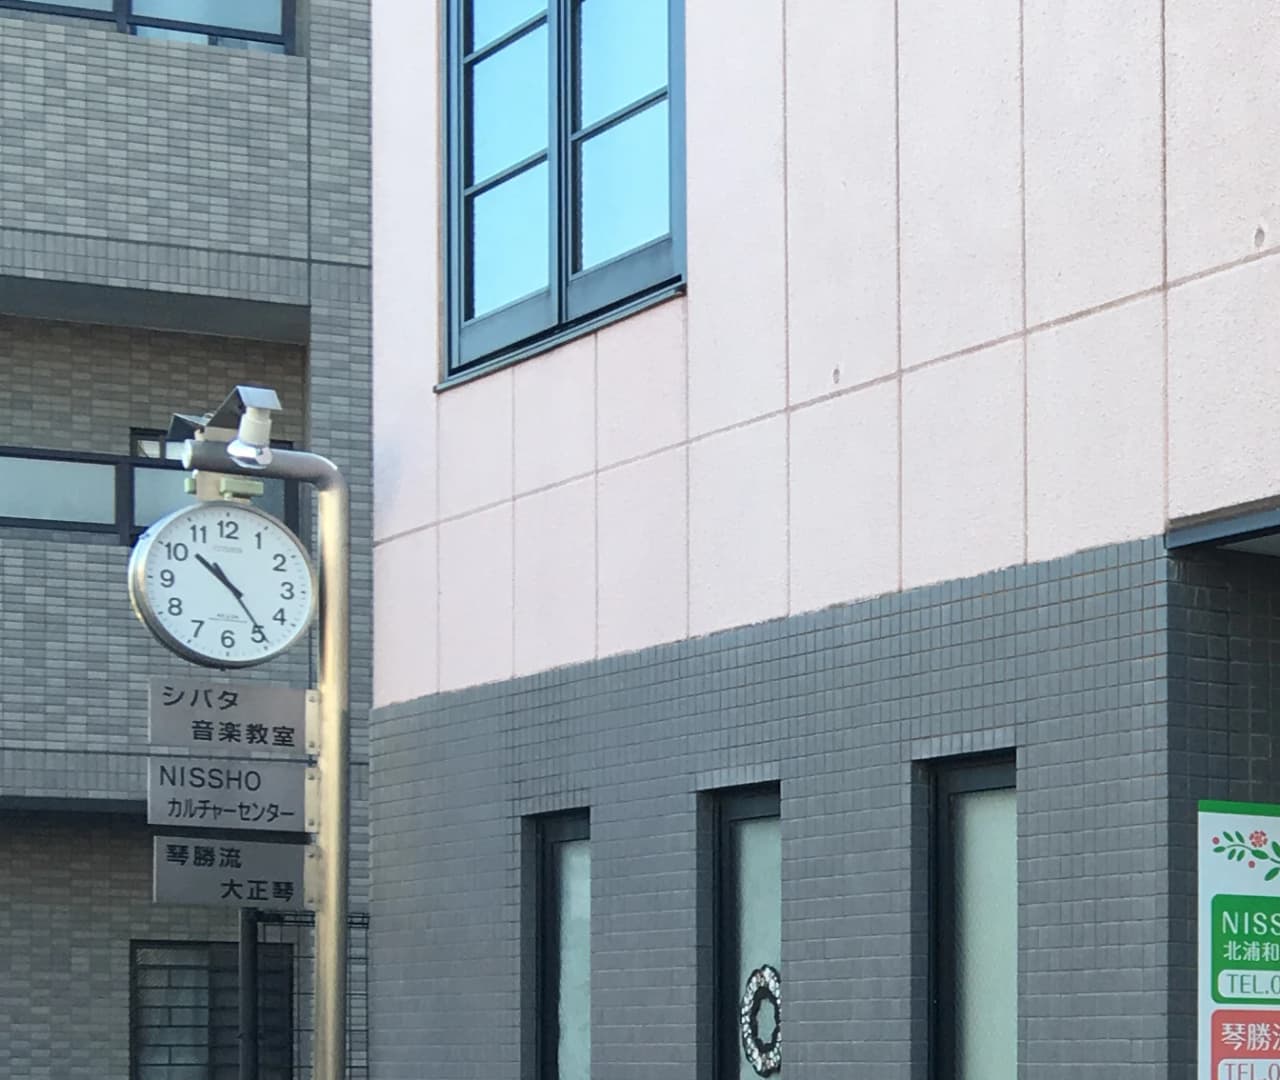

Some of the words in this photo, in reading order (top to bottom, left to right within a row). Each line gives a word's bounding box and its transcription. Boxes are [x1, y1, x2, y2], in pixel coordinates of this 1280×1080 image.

[190, 525, 207, 543] 11
[217, 521, 239, 540] 12
[254, 533, 262, 549] 1
[165, 543, 189, 561] 10
[272, 554, 287, 571] 2
[160, 570, 174, 588] 9
[280, 582, 294, 600] 3
[168, 598, 182, 616] 8
[272, 608, 287, 625] 4
[192, 620, 204, 638] 7
[251, 625, 265, 644] 5
[220, 630, 235, 648] 6
[161, 686, 239, 711] シバタ
[192, 720, 296, 747] 音楽教室
[160, 765, 261, 791] NISSHO
[167, 798, 295, 822] カルチャーセンター
[166, 844, 241, 869] 琴勝流
[221, 879, 295, 903] 大正琴
